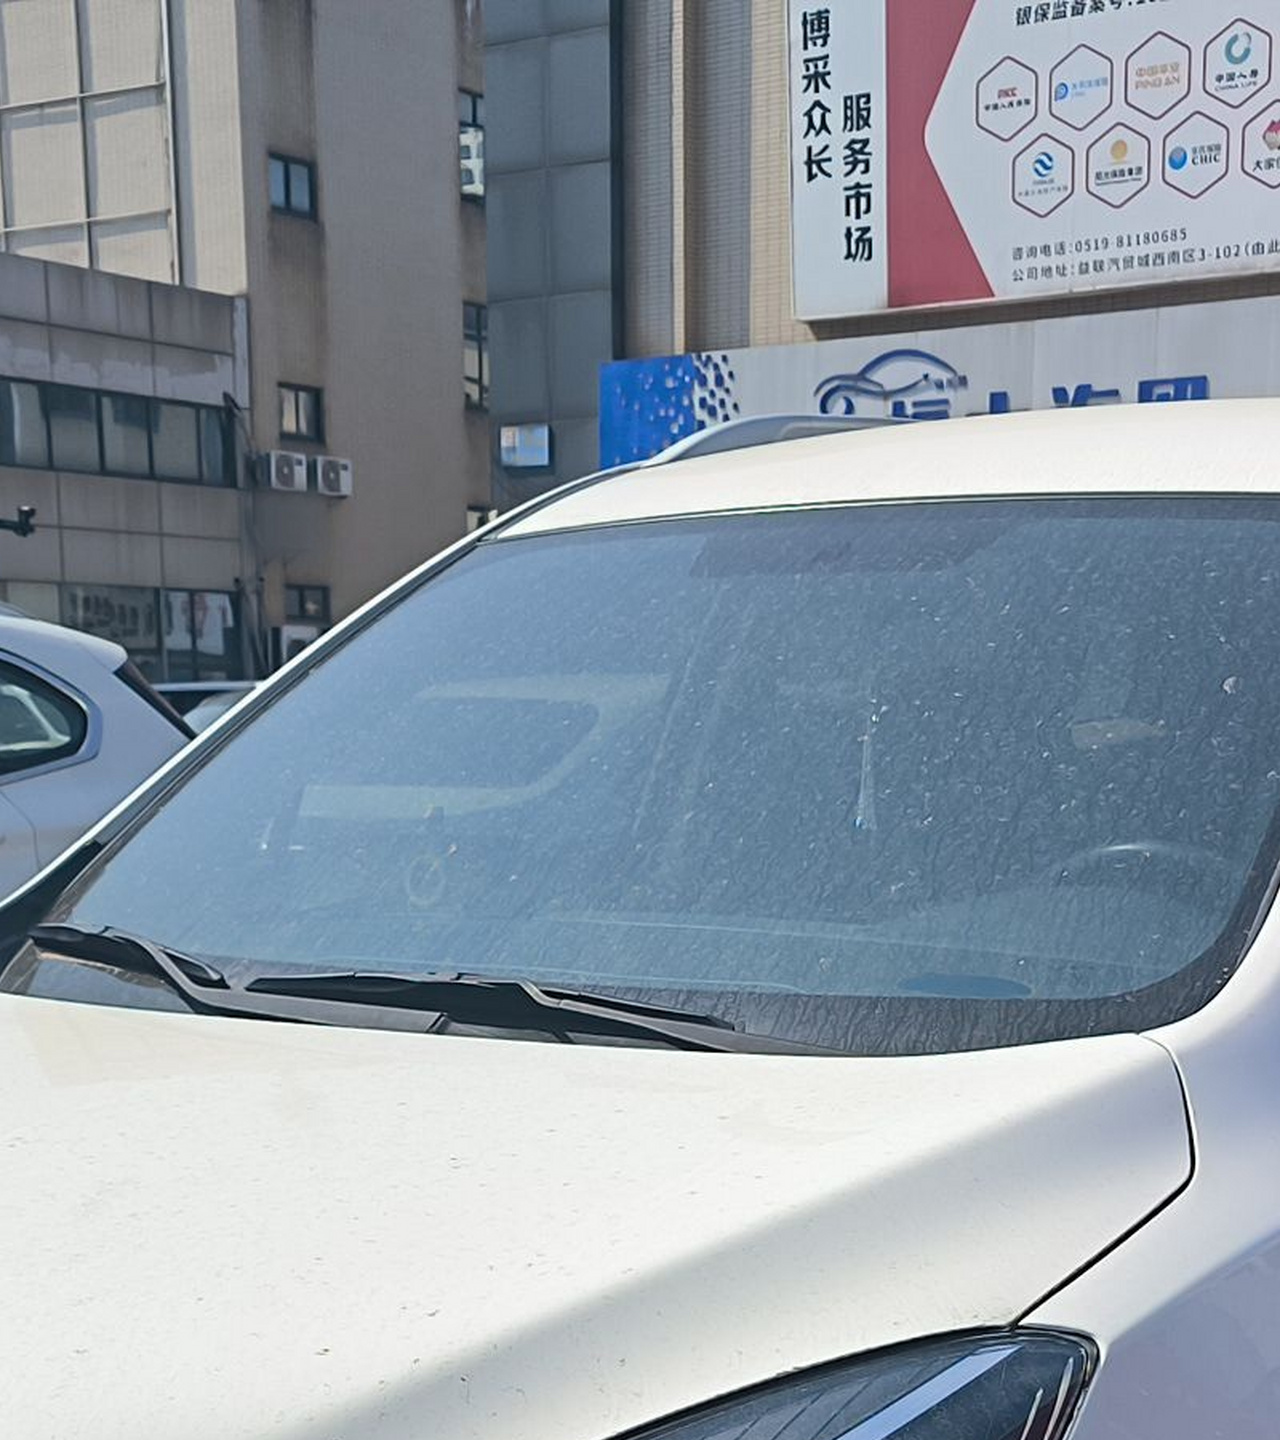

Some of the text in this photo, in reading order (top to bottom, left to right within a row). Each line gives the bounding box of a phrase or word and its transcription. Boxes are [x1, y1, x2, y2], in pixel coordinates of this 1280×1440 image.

[801, 8, 832, 183] 博采众长
[842, 92, 873, 262] 服务市场
